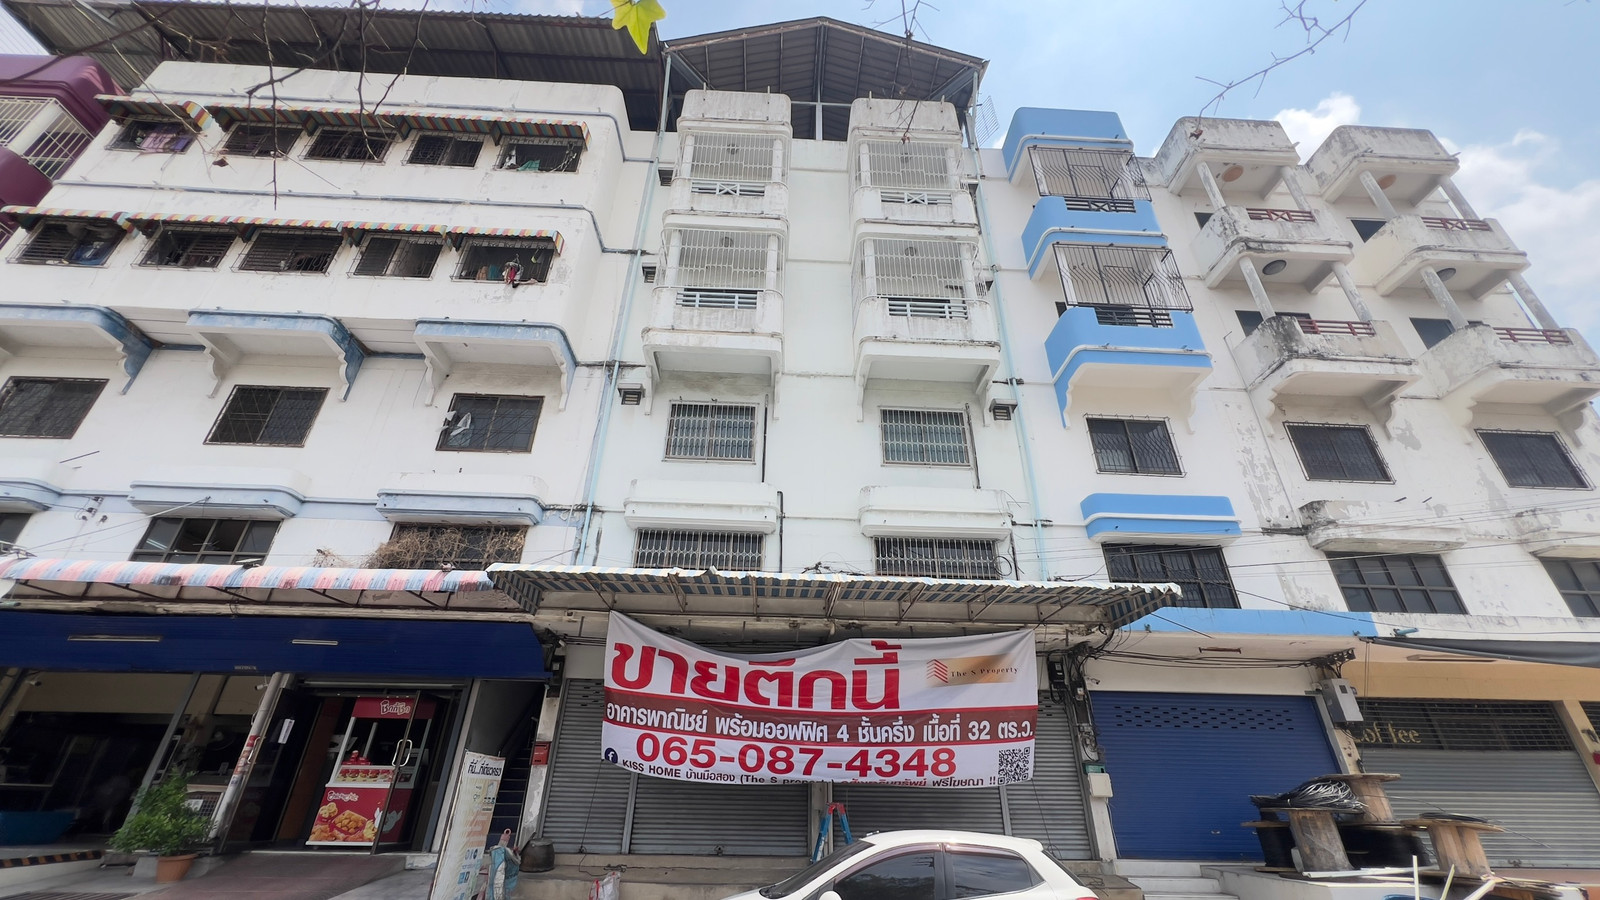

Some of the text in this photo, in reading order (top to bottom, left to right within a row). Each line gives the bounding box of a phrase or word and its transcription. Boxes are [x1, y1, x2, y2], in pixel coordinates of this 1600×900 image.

[980, 667, 1019, 675] Property
[606, 702, 1034, 743] อาคารพาณิชย์ พร้อมออฟฟิศ 4 ชั้นครึ่ง เนื้อที่ 32 ตร.ว.
[1354, 720, 1422, 744] offee
[636, 732, 957, 778] 065-087-4348
[622, 759, 645, 772] KISS
[648, 765, 681, 778] HOME
[740, 774, 765, 784] (The
